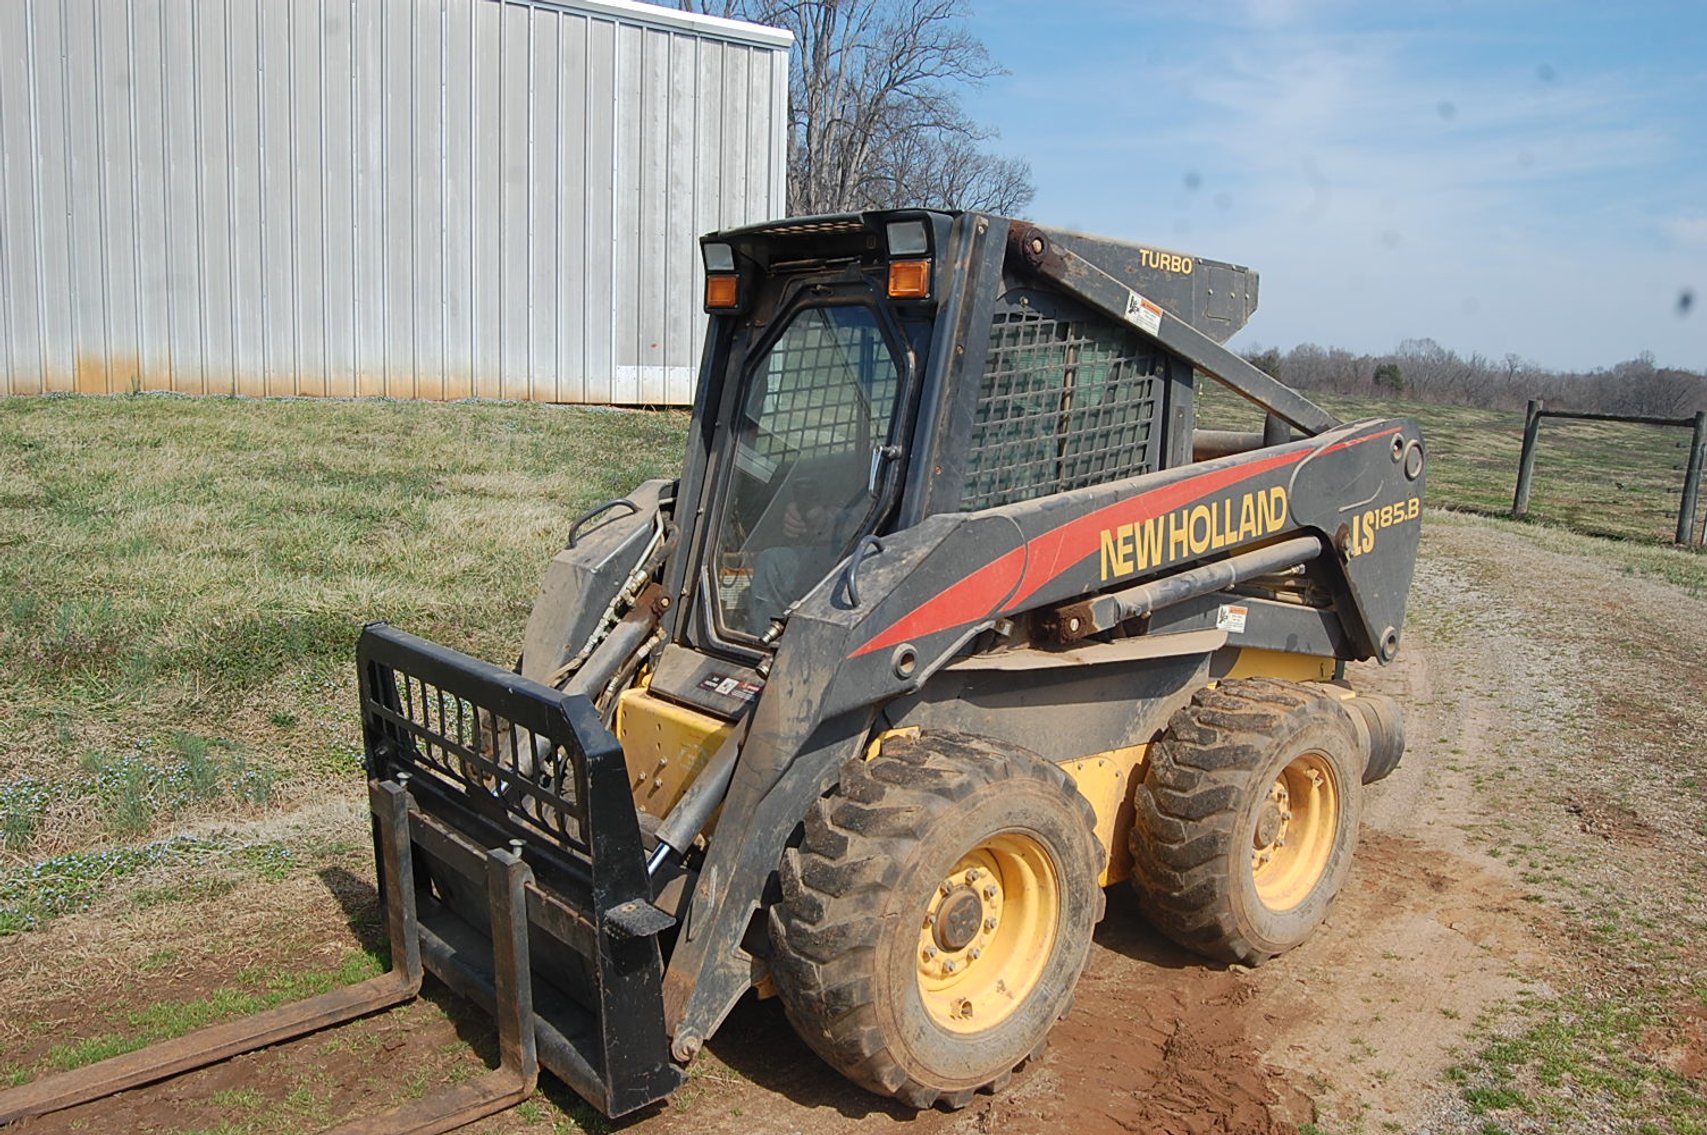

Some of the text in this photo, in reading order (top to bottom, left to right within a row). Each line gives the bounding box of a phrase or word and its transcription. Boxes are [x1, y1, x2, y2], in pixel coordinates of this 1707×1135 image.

[1139, 249, 1193, 274] TURBO
[1100, 486, 1288, 581] NEW HOLLAND
